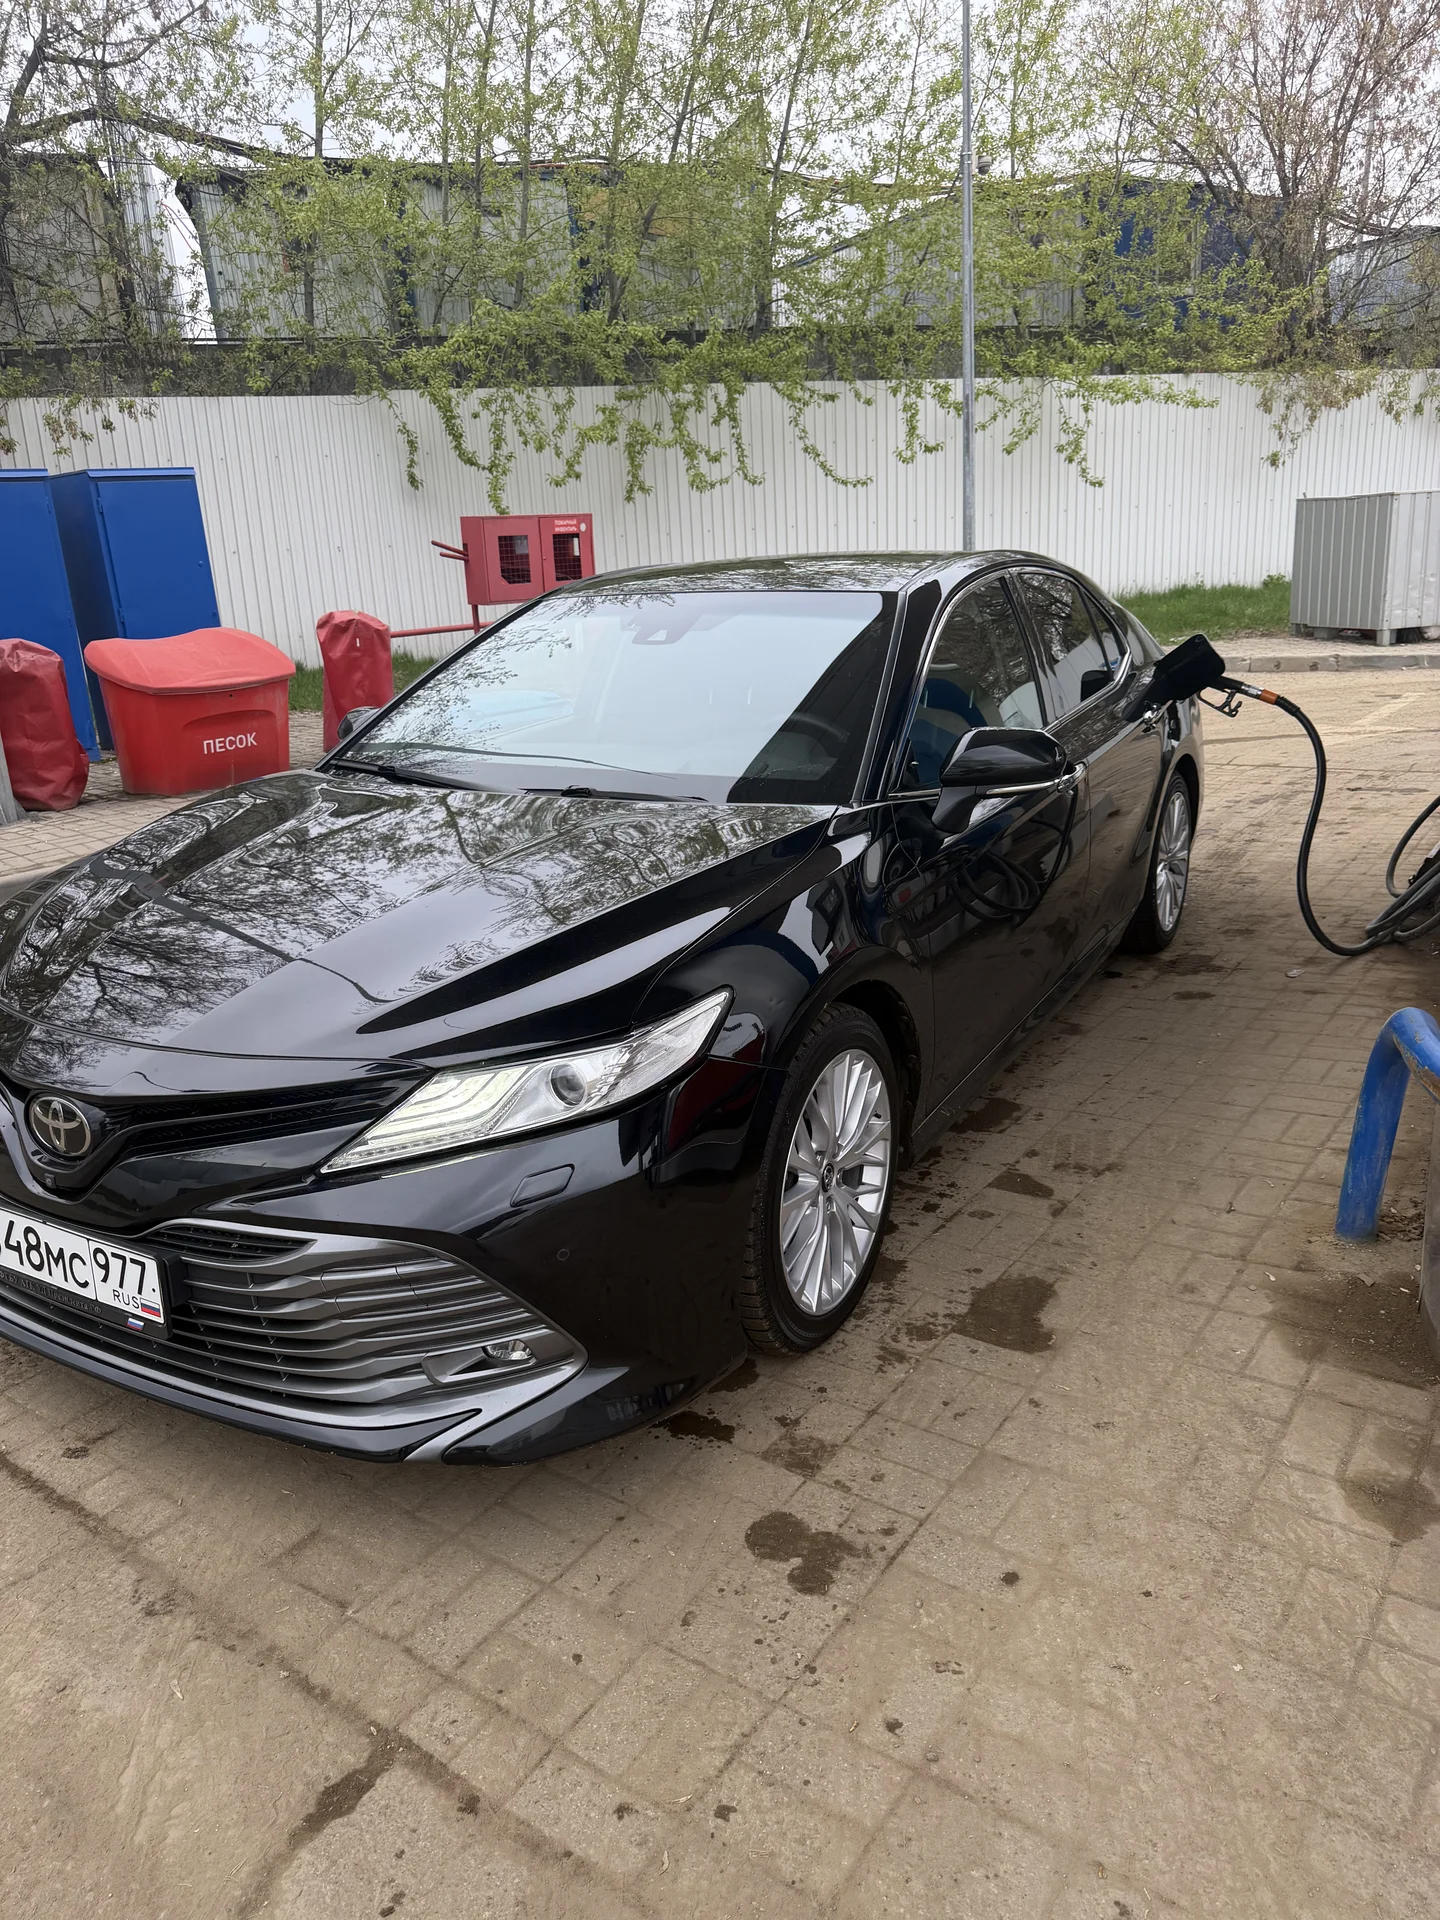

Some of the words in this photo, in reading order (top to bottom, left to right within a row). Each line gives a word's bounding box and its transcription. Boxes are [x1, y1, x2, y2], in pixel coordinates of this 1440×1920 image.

[203, 732, 257, 754] ПЕСОК
[0, 1220, 90, 1289] 48МС
[93, 1247, 146, 1295] 977
[112, 1289, 140, 1309] RUS
